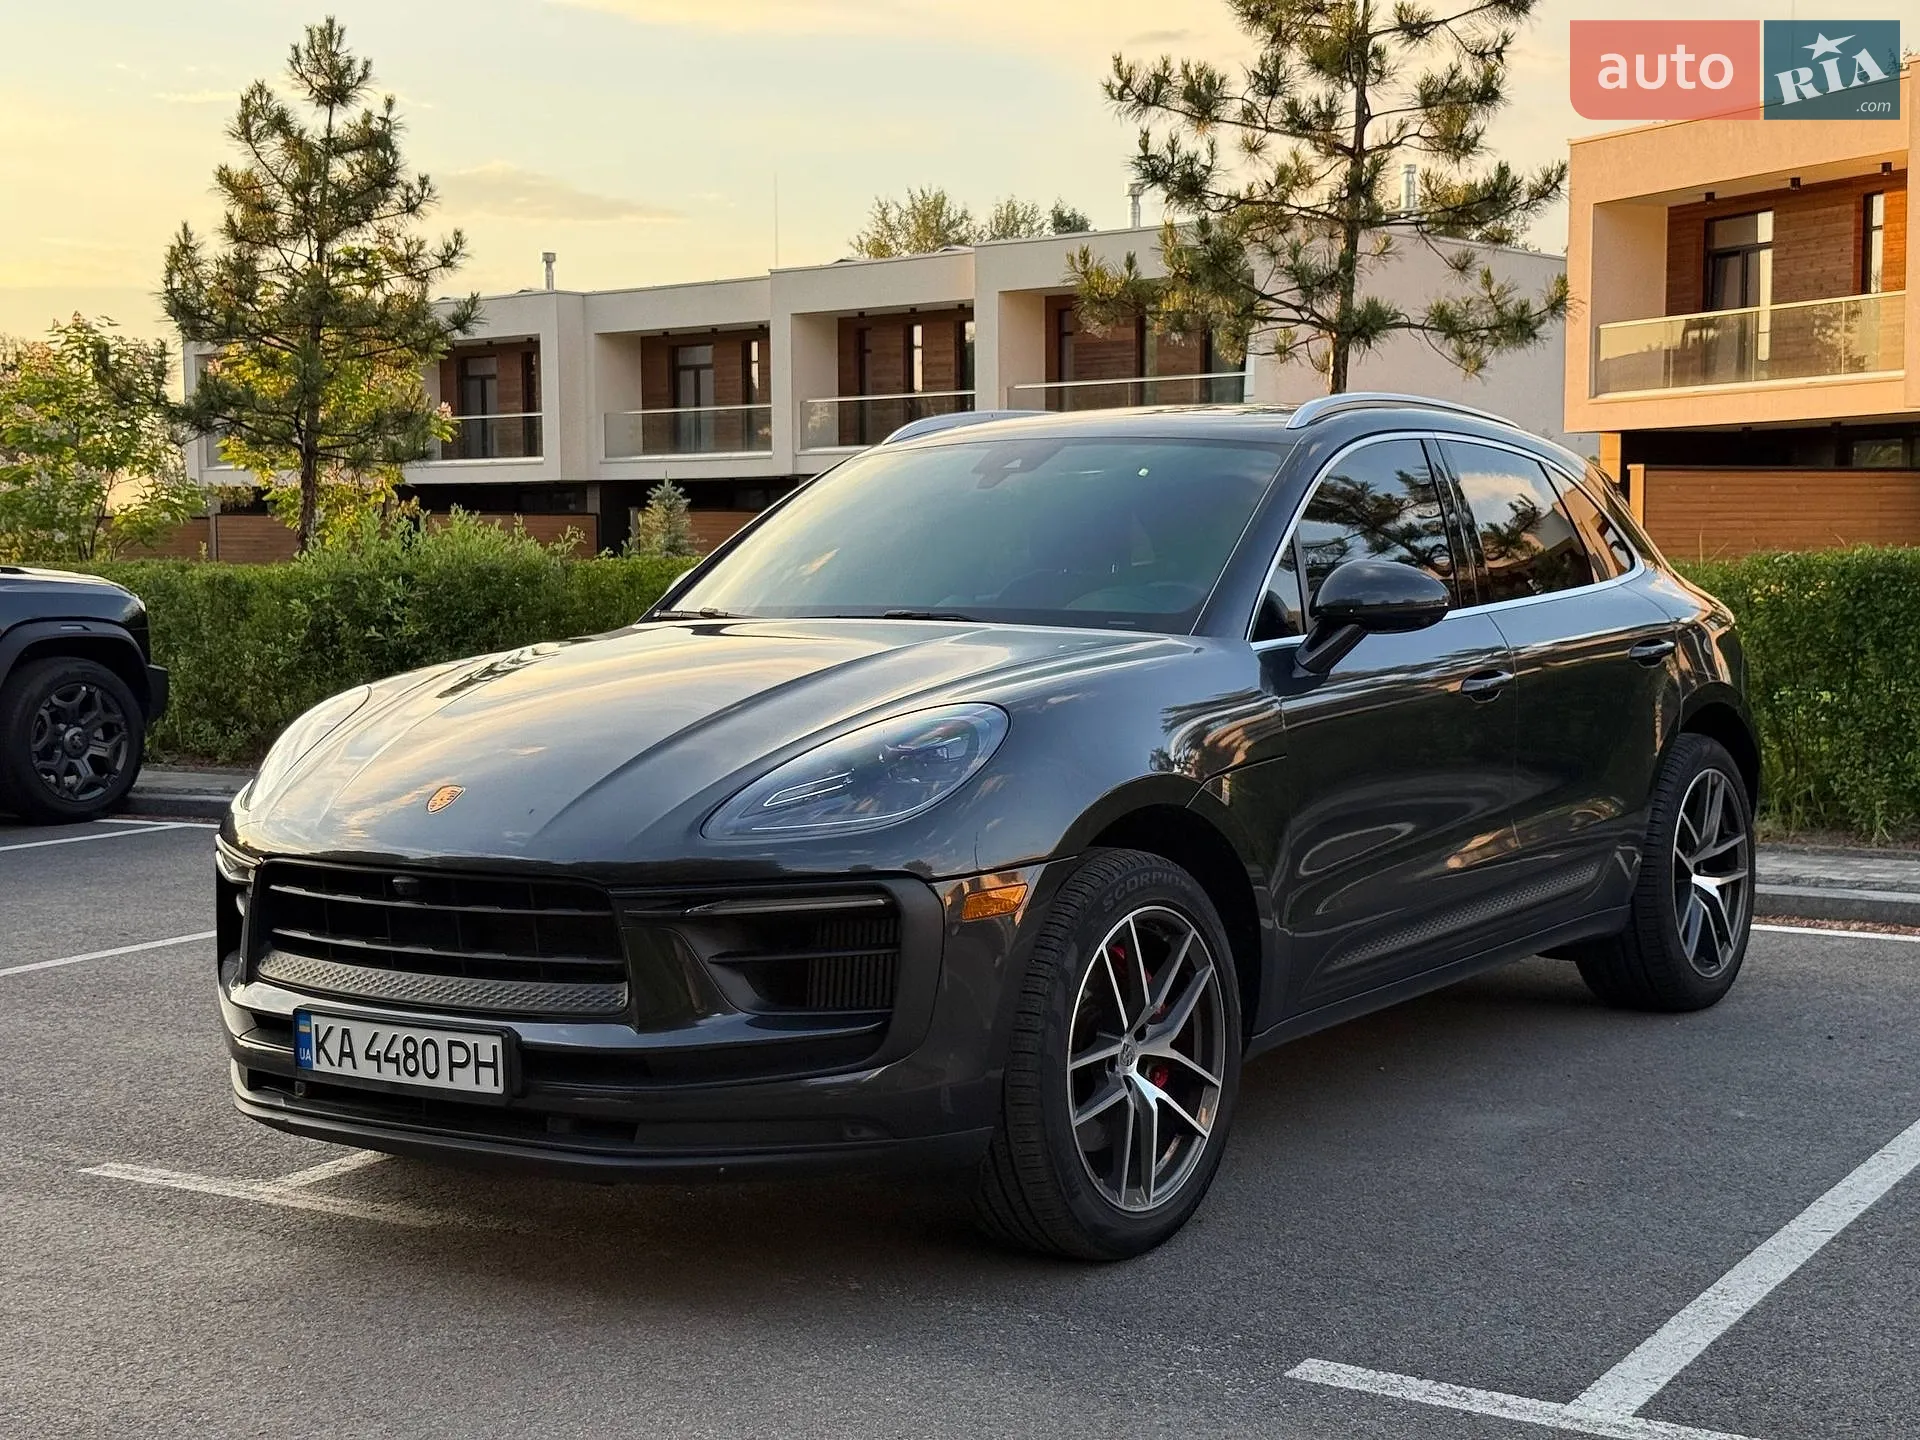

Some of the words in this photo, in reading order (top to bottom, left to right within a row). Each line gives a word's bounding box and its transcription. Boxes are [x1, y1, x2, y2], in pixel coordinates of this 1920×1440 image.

[1102, 871, 1192, 913] SCORPION
[299, 1048, 313, 1062] UA
[314, 1024, 357, 1070] KA
[364, 1031, 440, 1080] 4480
[447, 1039, 500, 1087] PH
